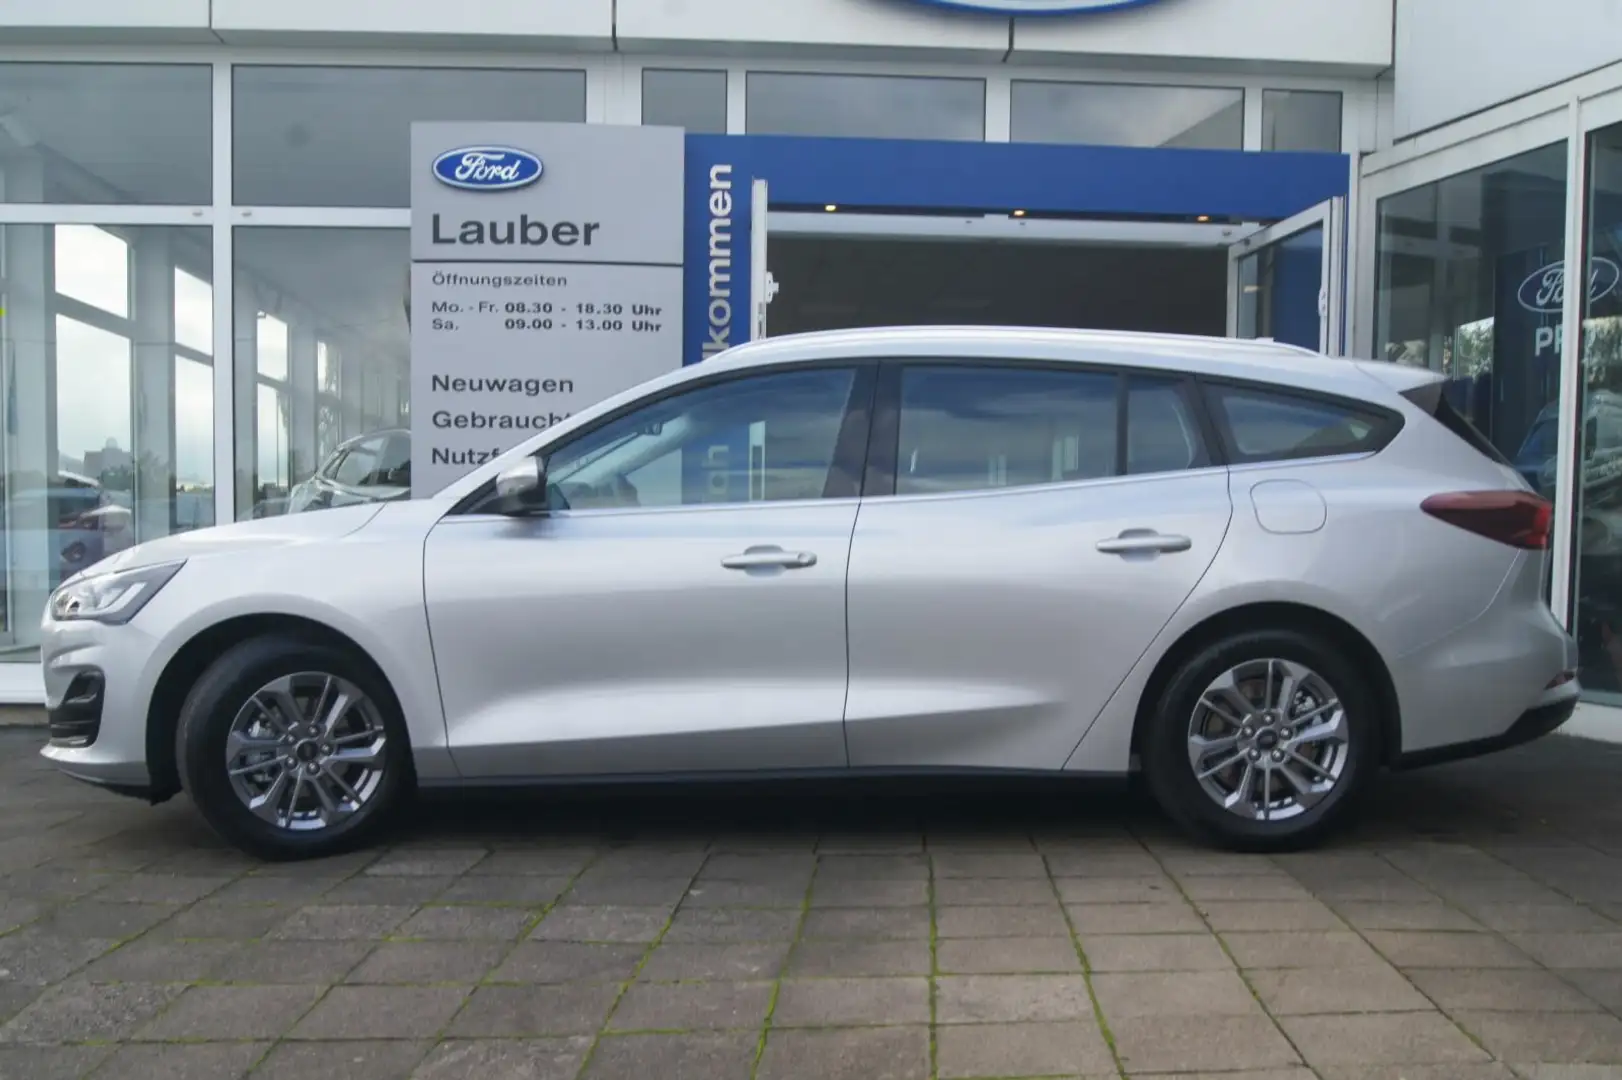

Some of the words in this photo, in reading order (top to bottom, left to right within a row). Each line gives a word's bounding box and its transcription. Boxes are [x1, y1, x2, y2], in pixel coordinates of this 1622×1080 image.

[455, 152, 521, 181] Ford
[432, 213, 600, 246] Lauber
[432, 270, 567, 288] Öffnungszeiten
[432, 301, 464, 313] Mo.
[478, 301, 499, 314] Fr.
[505, 302, 553, 314] 08.30
[576, 303, 623, 315] 18.30
[632, 304, 662, 316] Uhr
[505, 319, 553, 330] 09.00
[576, 319, 623, 331] 13.00
[632, 320, 662, 332] Uhr
[432, 375, 574, 395] Neuwagen
